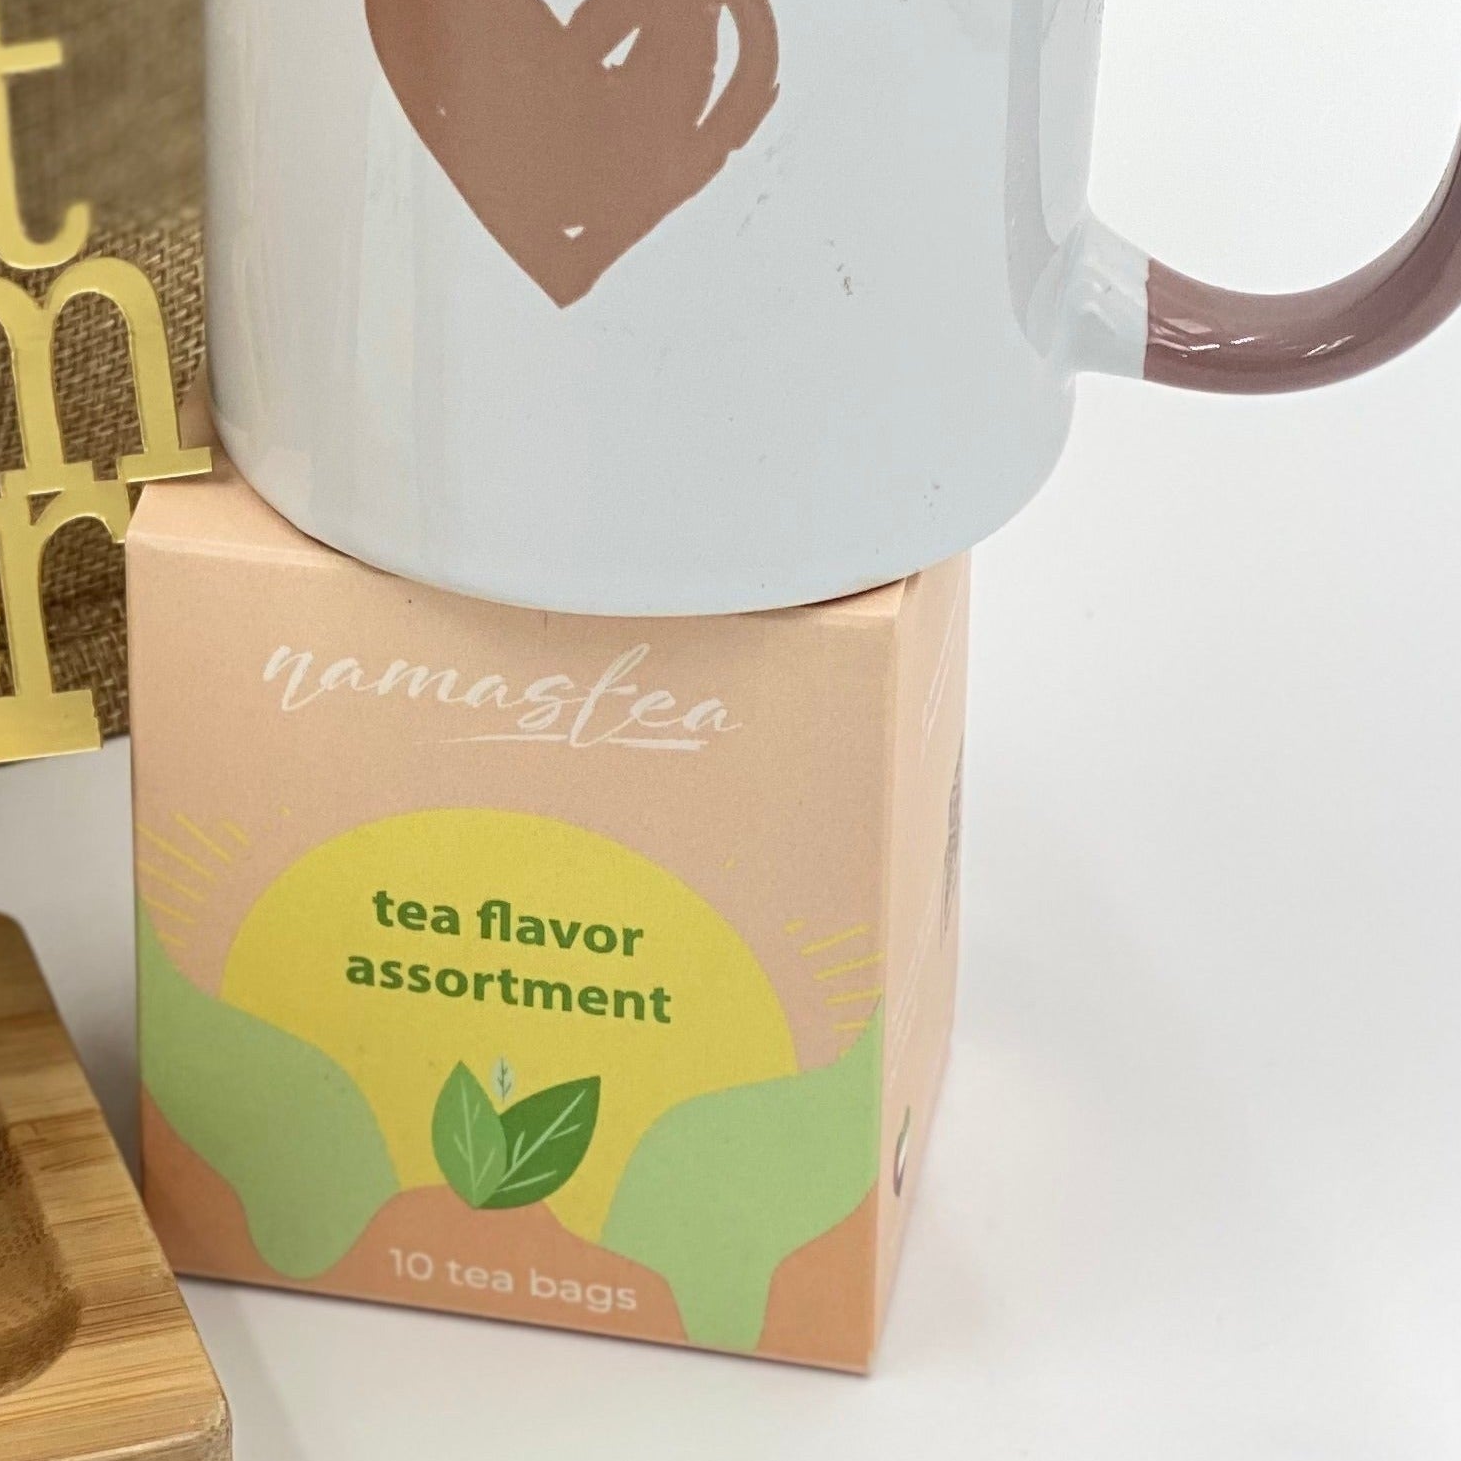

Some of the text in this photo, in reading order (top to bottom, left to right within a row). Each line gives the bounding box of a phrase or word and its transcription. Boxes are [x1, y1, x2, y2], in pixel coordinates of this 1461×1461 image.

[262, 642, 743, 749] namastea
[372, 889, 645, 957] tea flavor
[345, 954, 673, 1024] assortment
[388, 1247, 638, 1314] 10 tea bags
